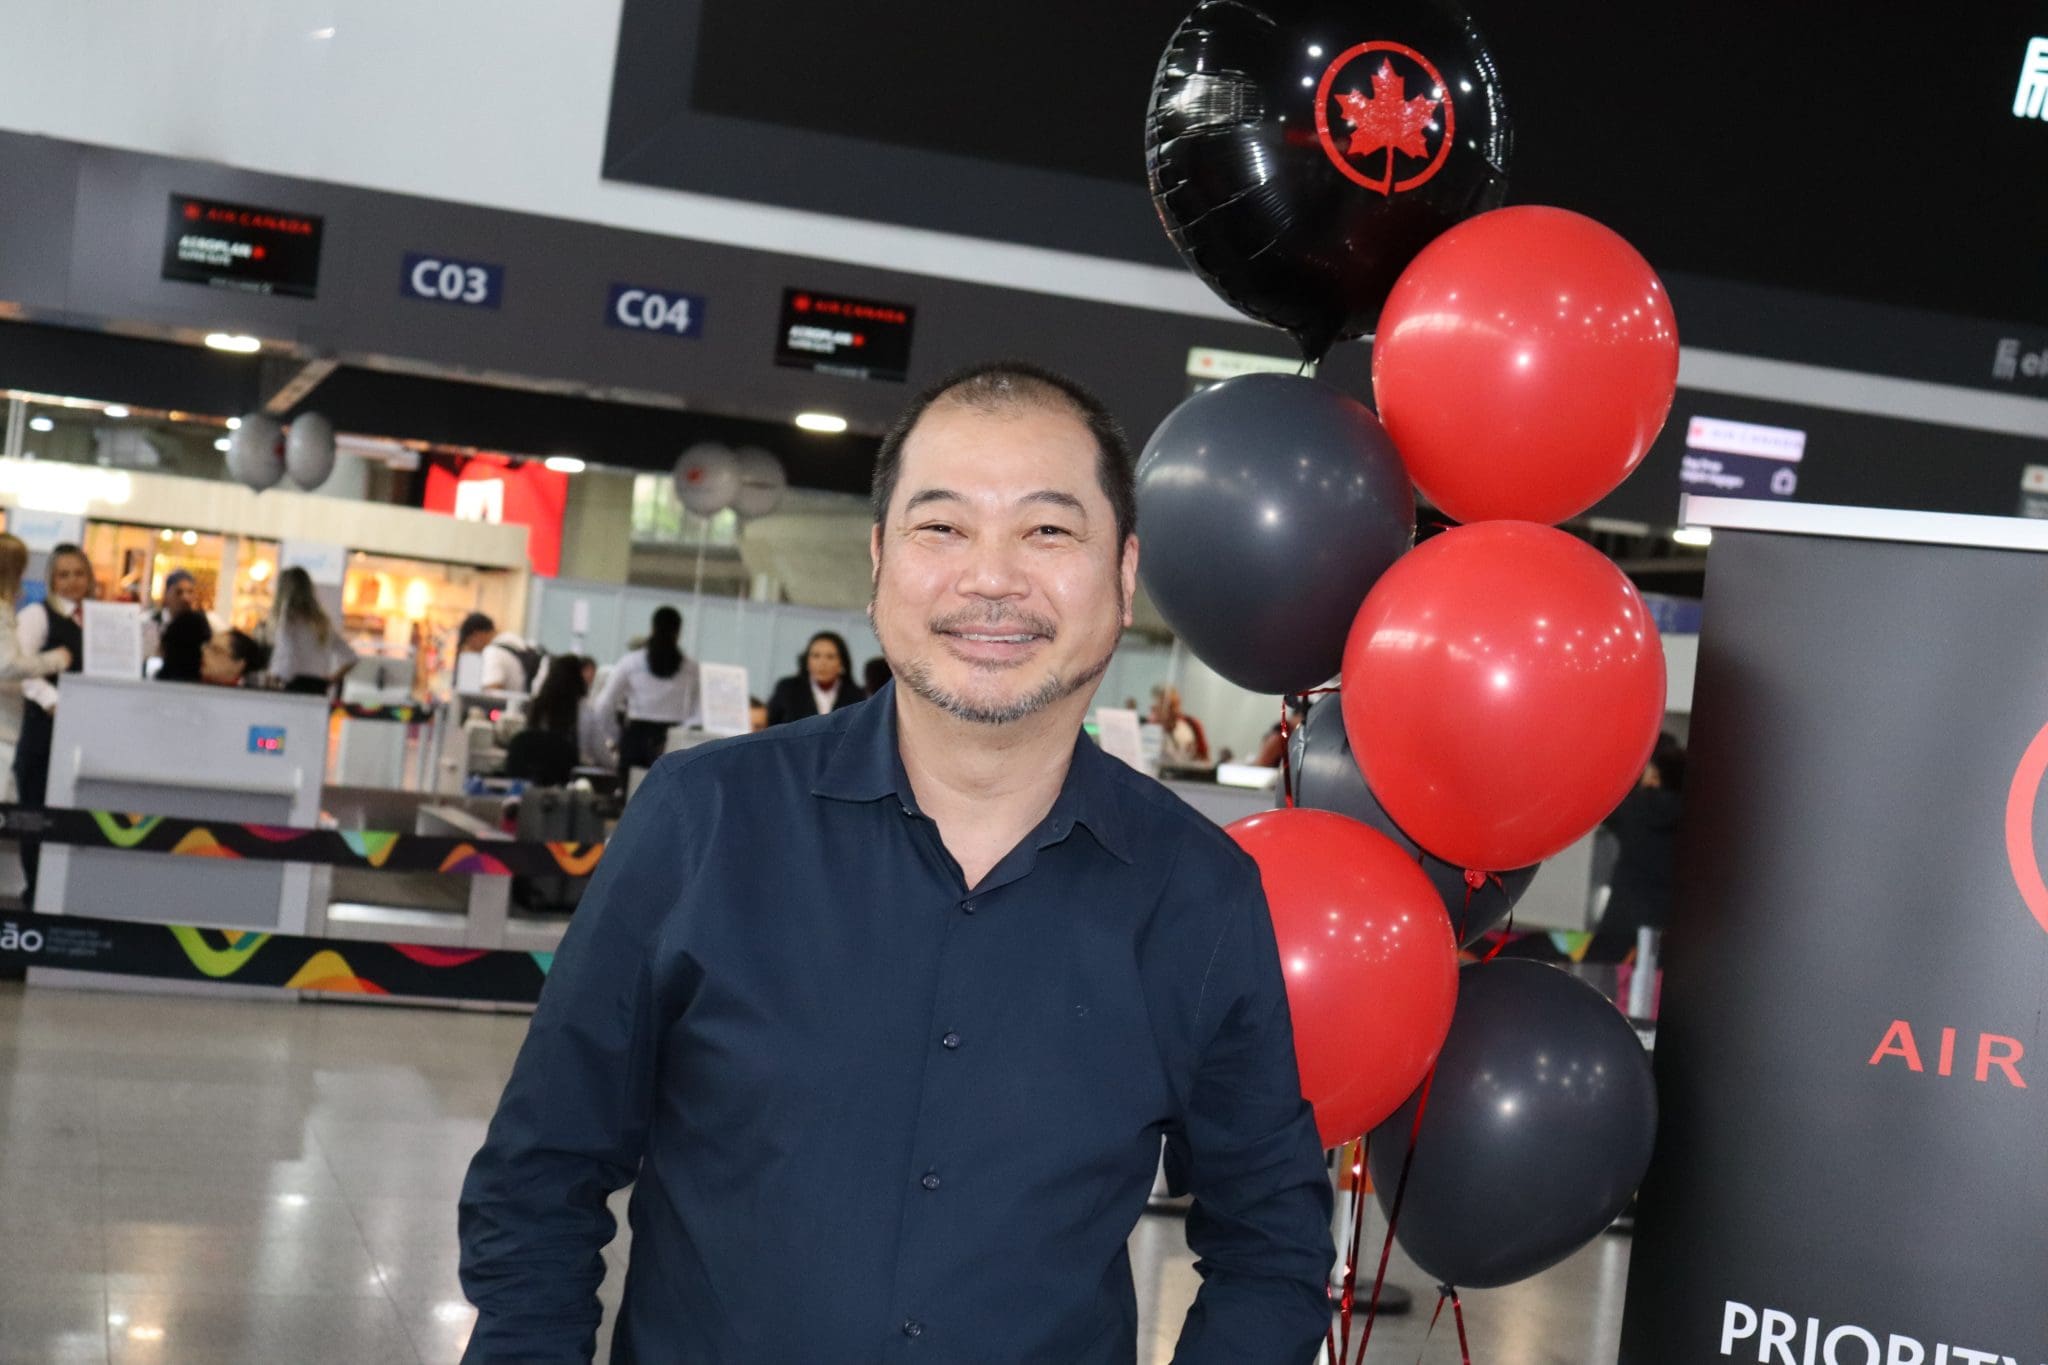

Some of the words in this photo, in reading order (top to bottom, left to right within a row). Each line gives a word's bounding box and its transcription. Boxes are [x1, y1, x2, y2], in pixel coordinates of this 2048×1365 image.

[410, 259, 488, 303] C03
[615, 289, 690, 333] C04
[1867, 1018, 2029, 1090] AIR
[1719, 1299, 2048, 1365] PRIOR
